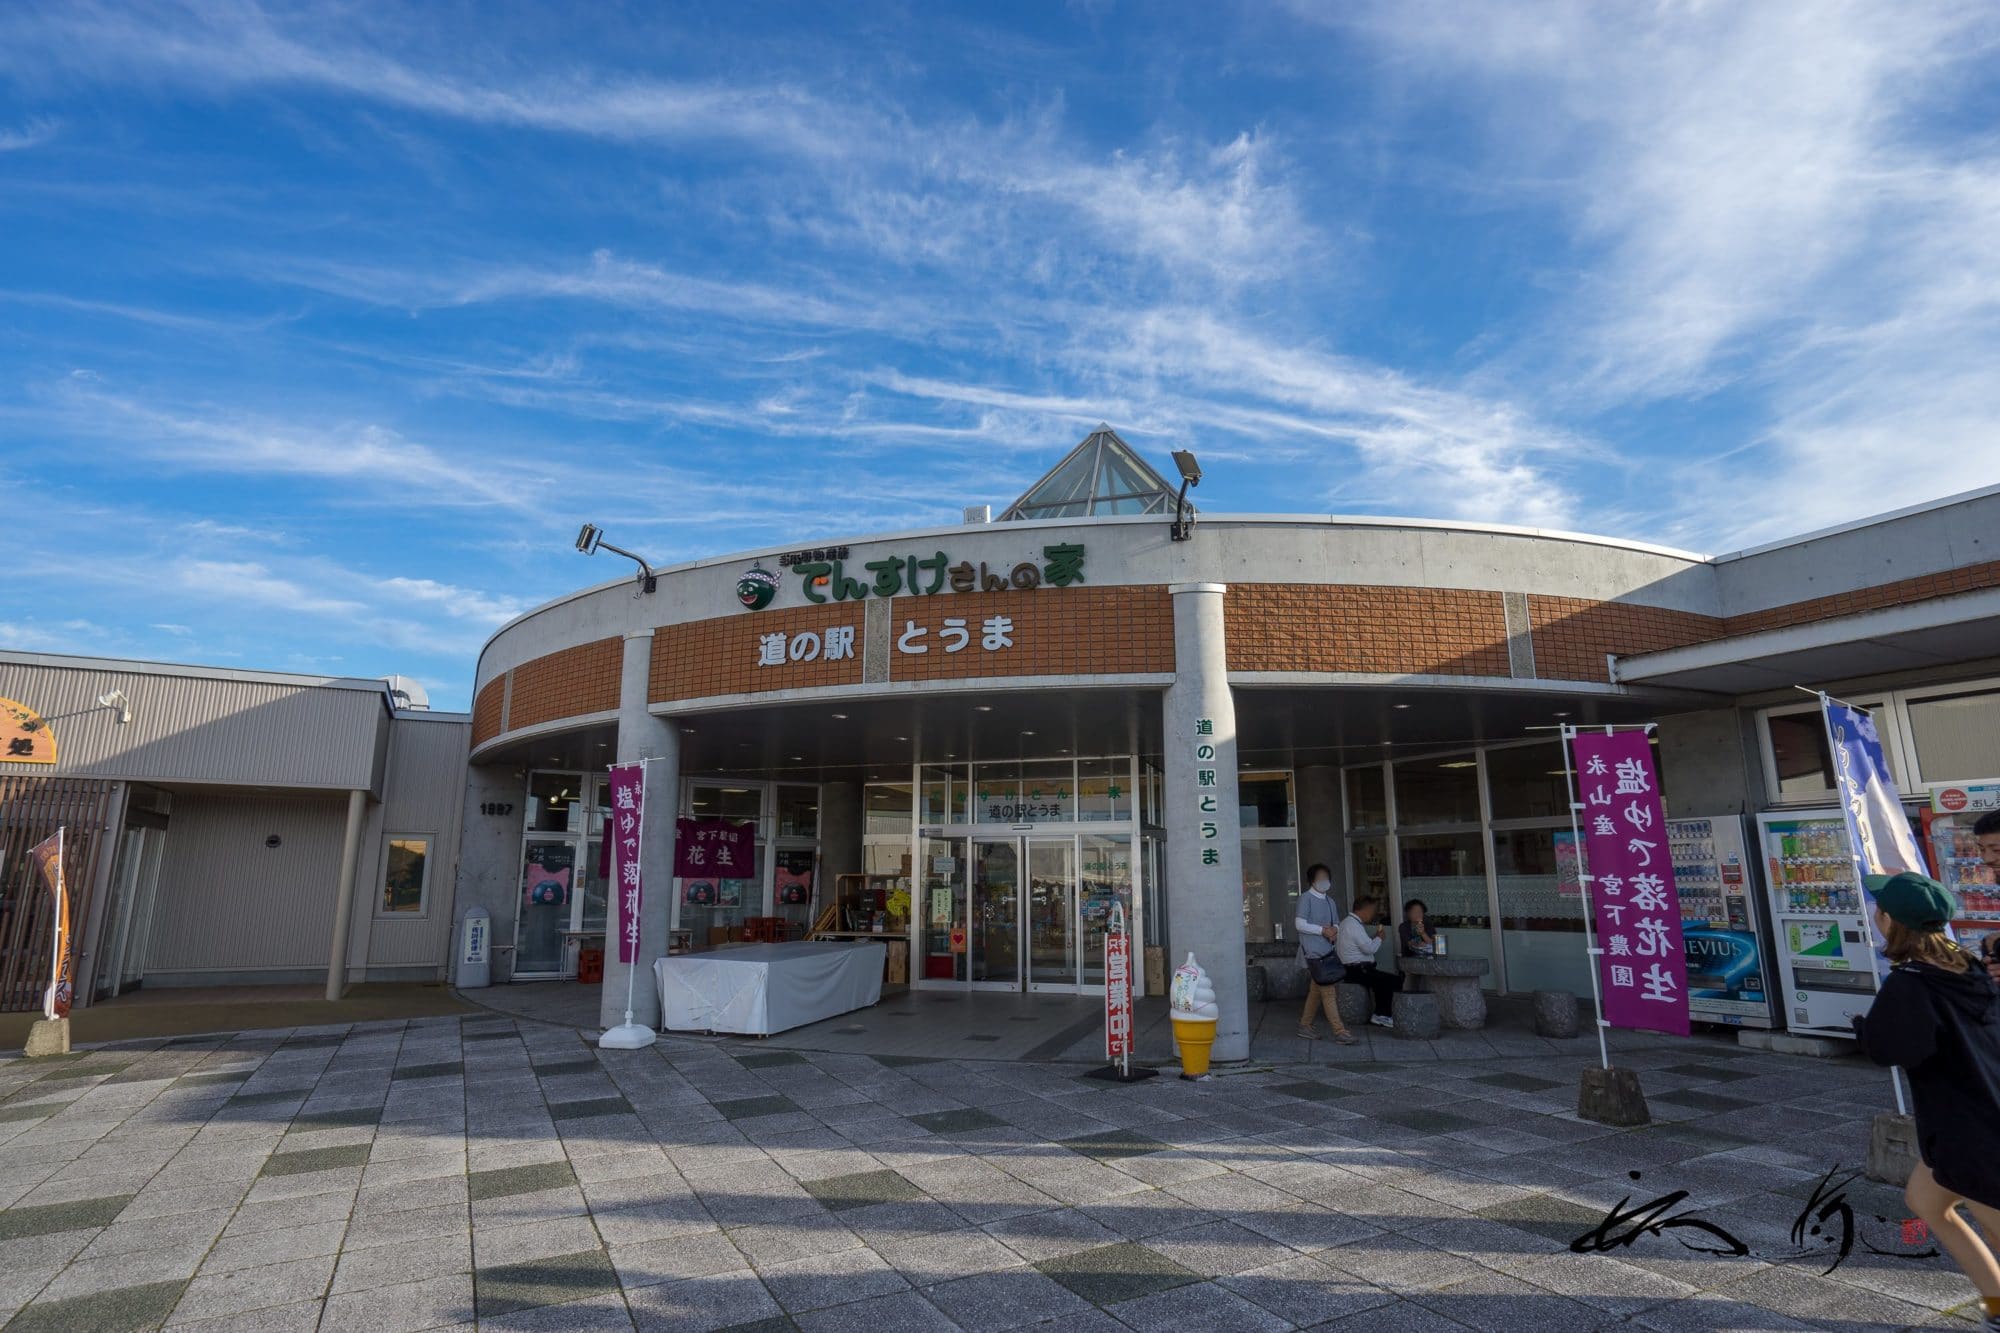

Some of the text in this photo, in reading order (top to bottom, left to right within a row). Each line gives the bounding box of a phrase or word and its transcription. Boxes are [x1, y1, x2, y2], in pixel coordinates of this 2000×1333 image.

[793, 543, 1085, 603] でんすけさんの家
[758, 615, 1014, 667] 道の駅 とうま
[988, 803, 1060, 819] 道の駅とうま
[1196, 720, 1218, 865] 道の駅とうま
[617, 786, 640, 944] 塩ゆで落花生
[687, 845, 734, 867] 花生
[1683, 940, 1742, 957] EVIUS
[1109, 951, 1130, 1040] 営業中
